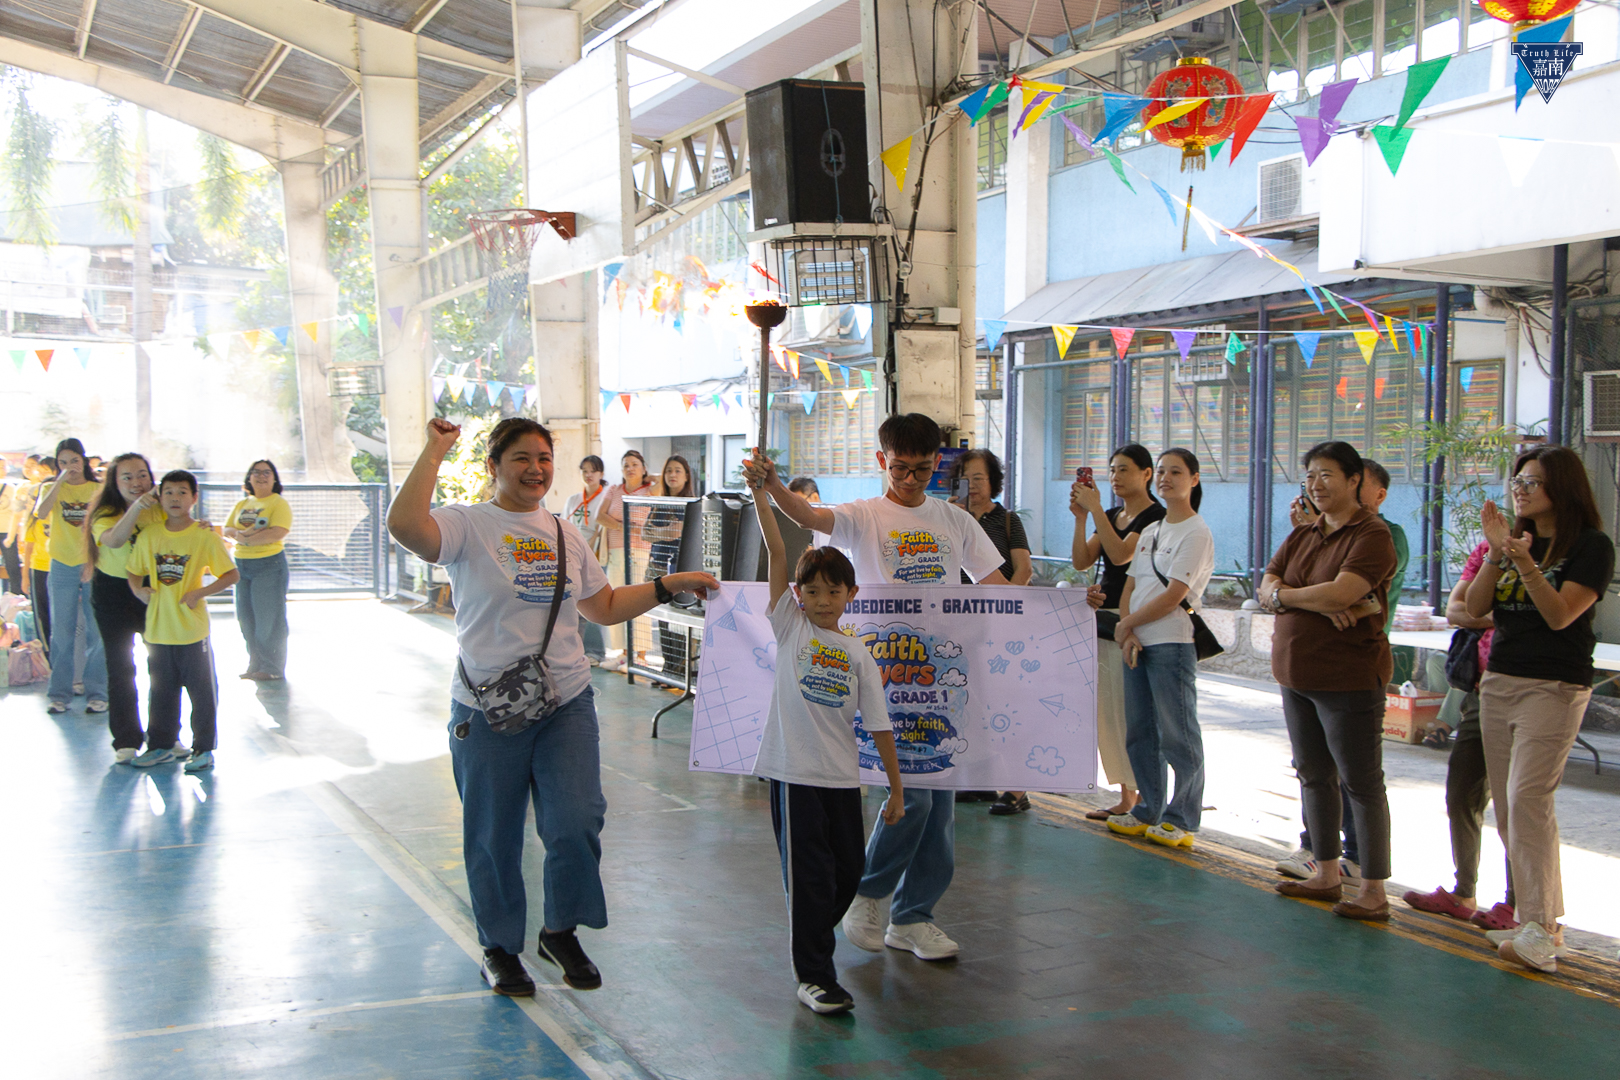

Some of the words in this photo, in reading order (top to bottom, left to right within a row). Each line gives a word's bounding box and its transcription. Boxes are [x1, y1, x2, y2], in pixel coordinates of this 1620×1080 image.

[514, 537, 551, 551] Faith
[900, 531, 935, 544] Faith
[512, 549, 557, 564] Flyers
[897, 543, 938, 557] Flyers
[844, 598, 923, 614] OBEDIENCE
[942, 598, 1024, 615] GRATITUDE
[818, 644, 849, 662] Faith
[812, 654, 850, 672] Flyers
[827, 671, 847, 682] GRADE
[878, 663, 936, 688] yers
[889, 689, 939, 705] GRADE
[941, 689, 949, 703] 1
[905, 717, 916, 730] by
[917, 716, 949, 733] faith,
[901, 729, 929, 742] sight.
